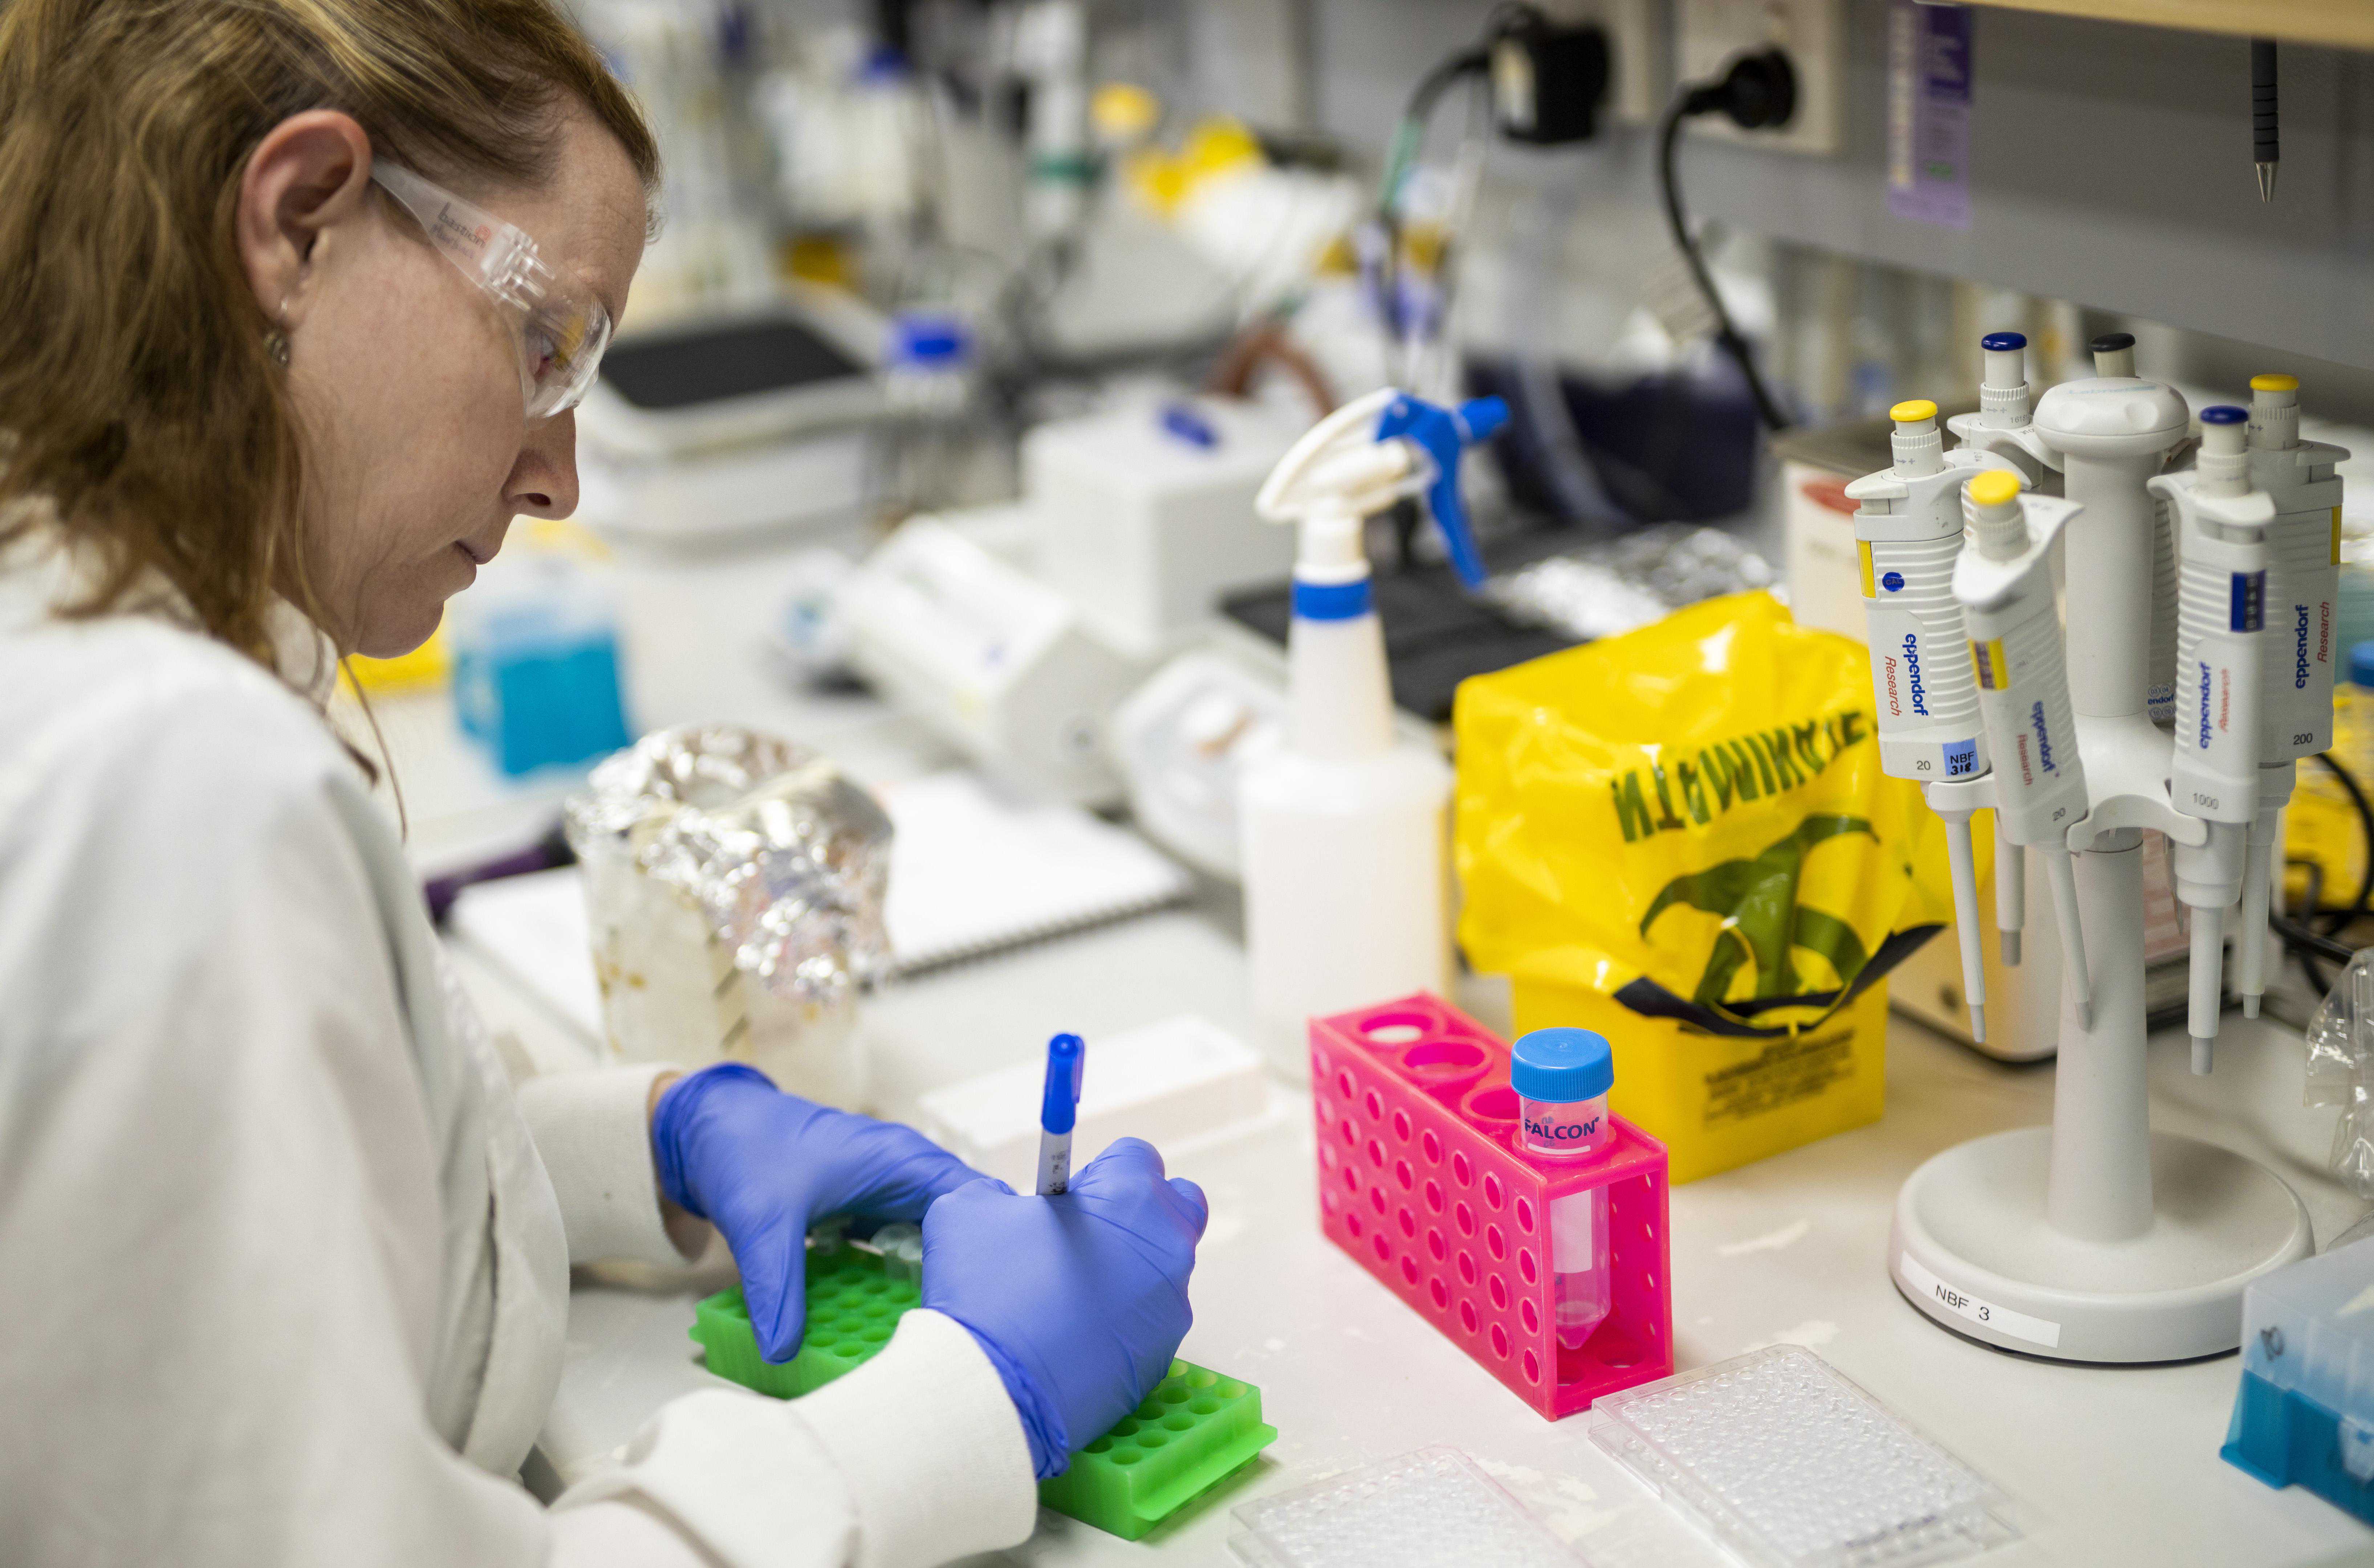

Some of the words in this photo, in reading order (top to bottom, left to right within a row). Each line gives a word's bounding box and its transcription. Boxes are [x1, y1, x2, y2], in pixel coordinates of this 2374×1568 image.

[2294, 604, 2310, 689] eppendorf
[2317, 601, 2330, 663] Research
[1885, 656, 1902, 716] Research
[1902, 633, 1928, 716] eppendorf
[2199, 661, 2212, 749] eppendorf
[1950, 751, 1975, 764] NBF
[2029, 700, 2056, 773] eppendorf
[2293, 733, 2313, 745] 200
[1916, 761, 1931, 771] 20
[2016, 734, 2033, 787] Research
[2052, 807, 2066, 822] 20
[2192, 792, 2219, 810] 1000
[1525, 1119, 1595, 1140] FALCON
[1936, 1284, 1969, 1309] NBF
[1979, 1307, 1989, 1321] 3
